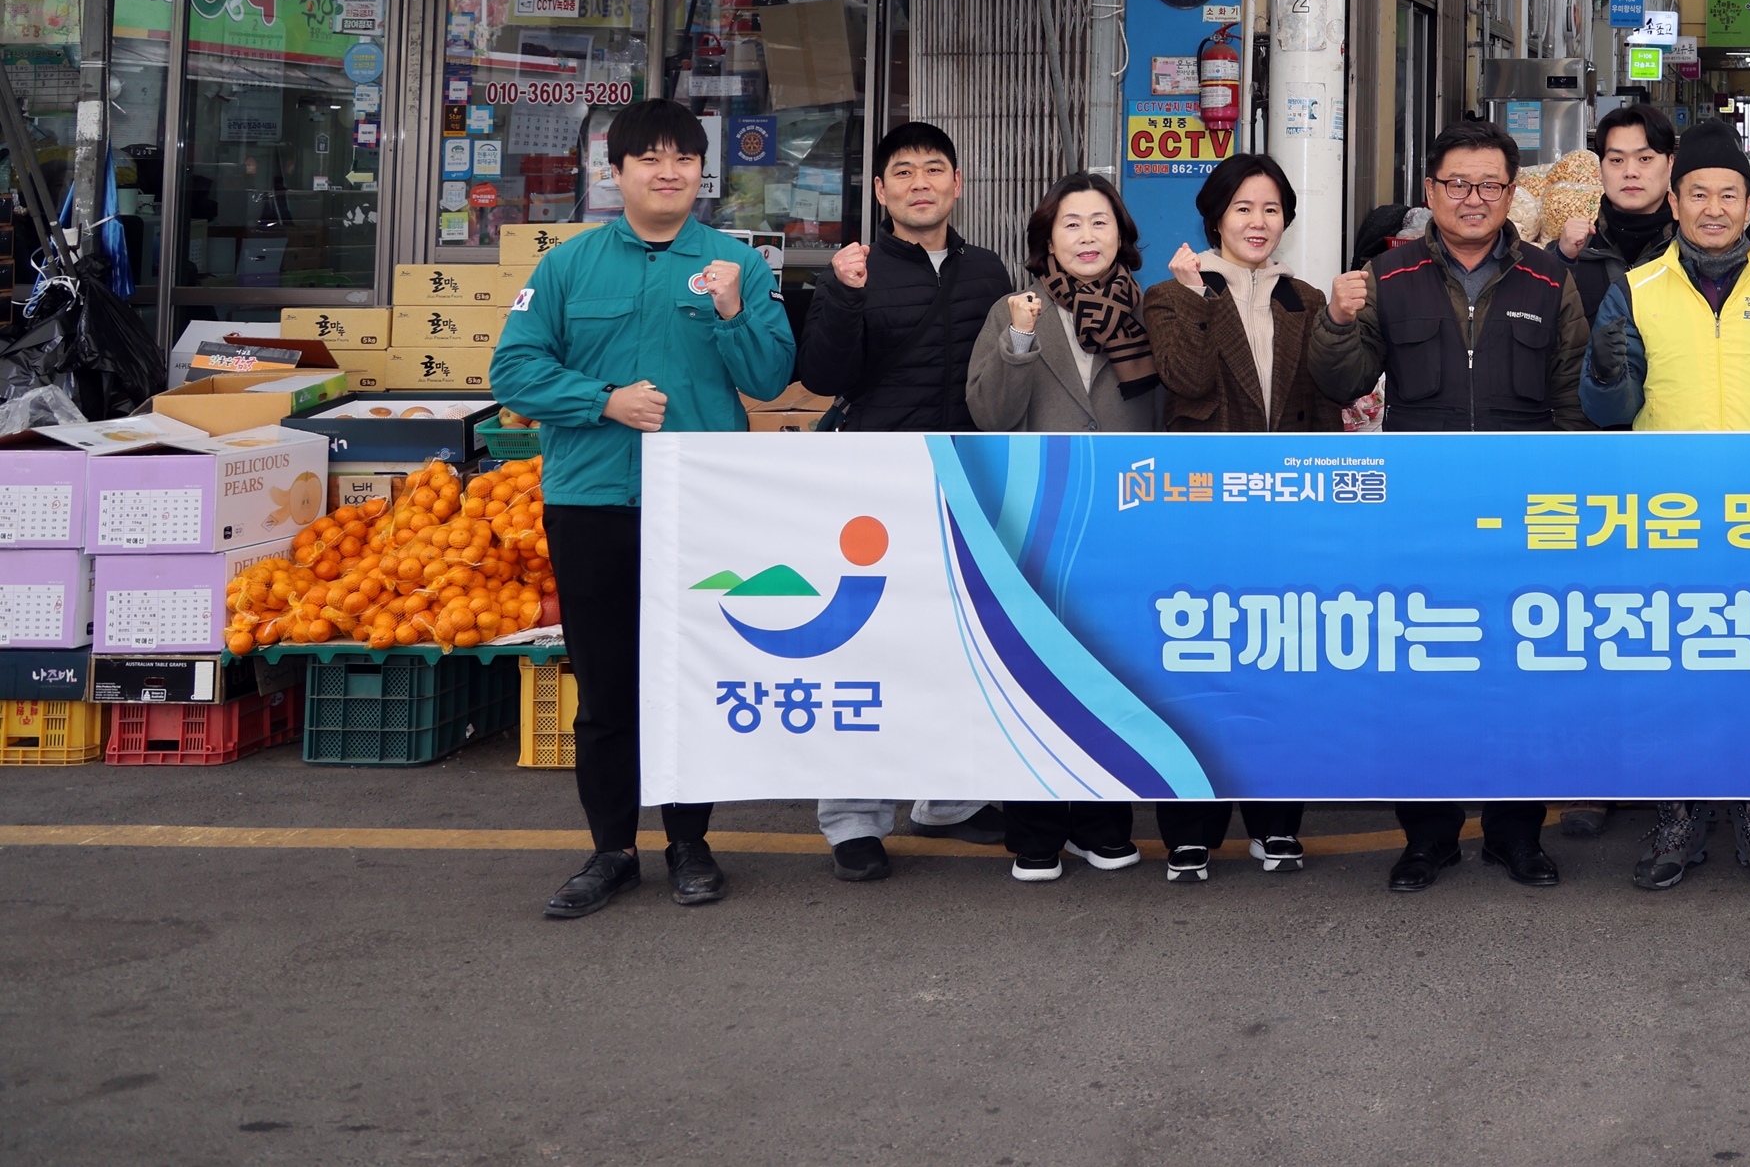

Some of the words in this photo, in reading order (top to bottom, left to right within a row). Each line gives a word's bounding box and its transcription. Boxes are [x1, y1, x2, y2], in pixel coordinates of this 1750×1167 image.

[1206, 7, 1239, 16] 소화기
[1611, 5, 1642, 13] 우미향식당
[344, 19, 374, 29] 참여점포
[487, 82, 632, 105] 010-3603-5280
[1148, 117, 1187, 129] 녹화중
[1131, 130, 1233, 159] CCTV
[1134, 164, 1169, 174] 장흥미래
[429, 271, 459, 293] 귤마루
[475, 293, 490, 301] 5kg
[315, 314, 345, 337] 귤마루
[427, 312, 458, 335] 귤마루
[361, 337, 377, 345] 5kg
[474, 334, 489, 342] 5kg
[420, 354, 451, 377] 귤마루
[360, 379, 376, 387] 5kg
[466, 377, 482, 385] 5kg
[224, 453, 290, 478] DELICIOUS
[1284, 457, 1301, 468] City
[1303, 457, 1313, 467] of
[1314, 457, 1340, 467] Nobel
[1341, 457, 1385, 467] Literature
[224, 476, 264, 497] PEARS
[352, 481, 372, 493] 배
[1163, 472, 1213, 502] 노벨
[1222, 471, 1325, 502] 문학도시
[1332, 470, 1387, 504] 장흥
[1524, 493, 1701, 550] 즐거운
[126, 536, 145, 545] 박애선
[1156, 589, 1484, 673] 함께하는
[134, 636, 154, 645] 박애선
[32, 667, 74, 684] 나주배
[716, 677, 884, 734] 장흥군
